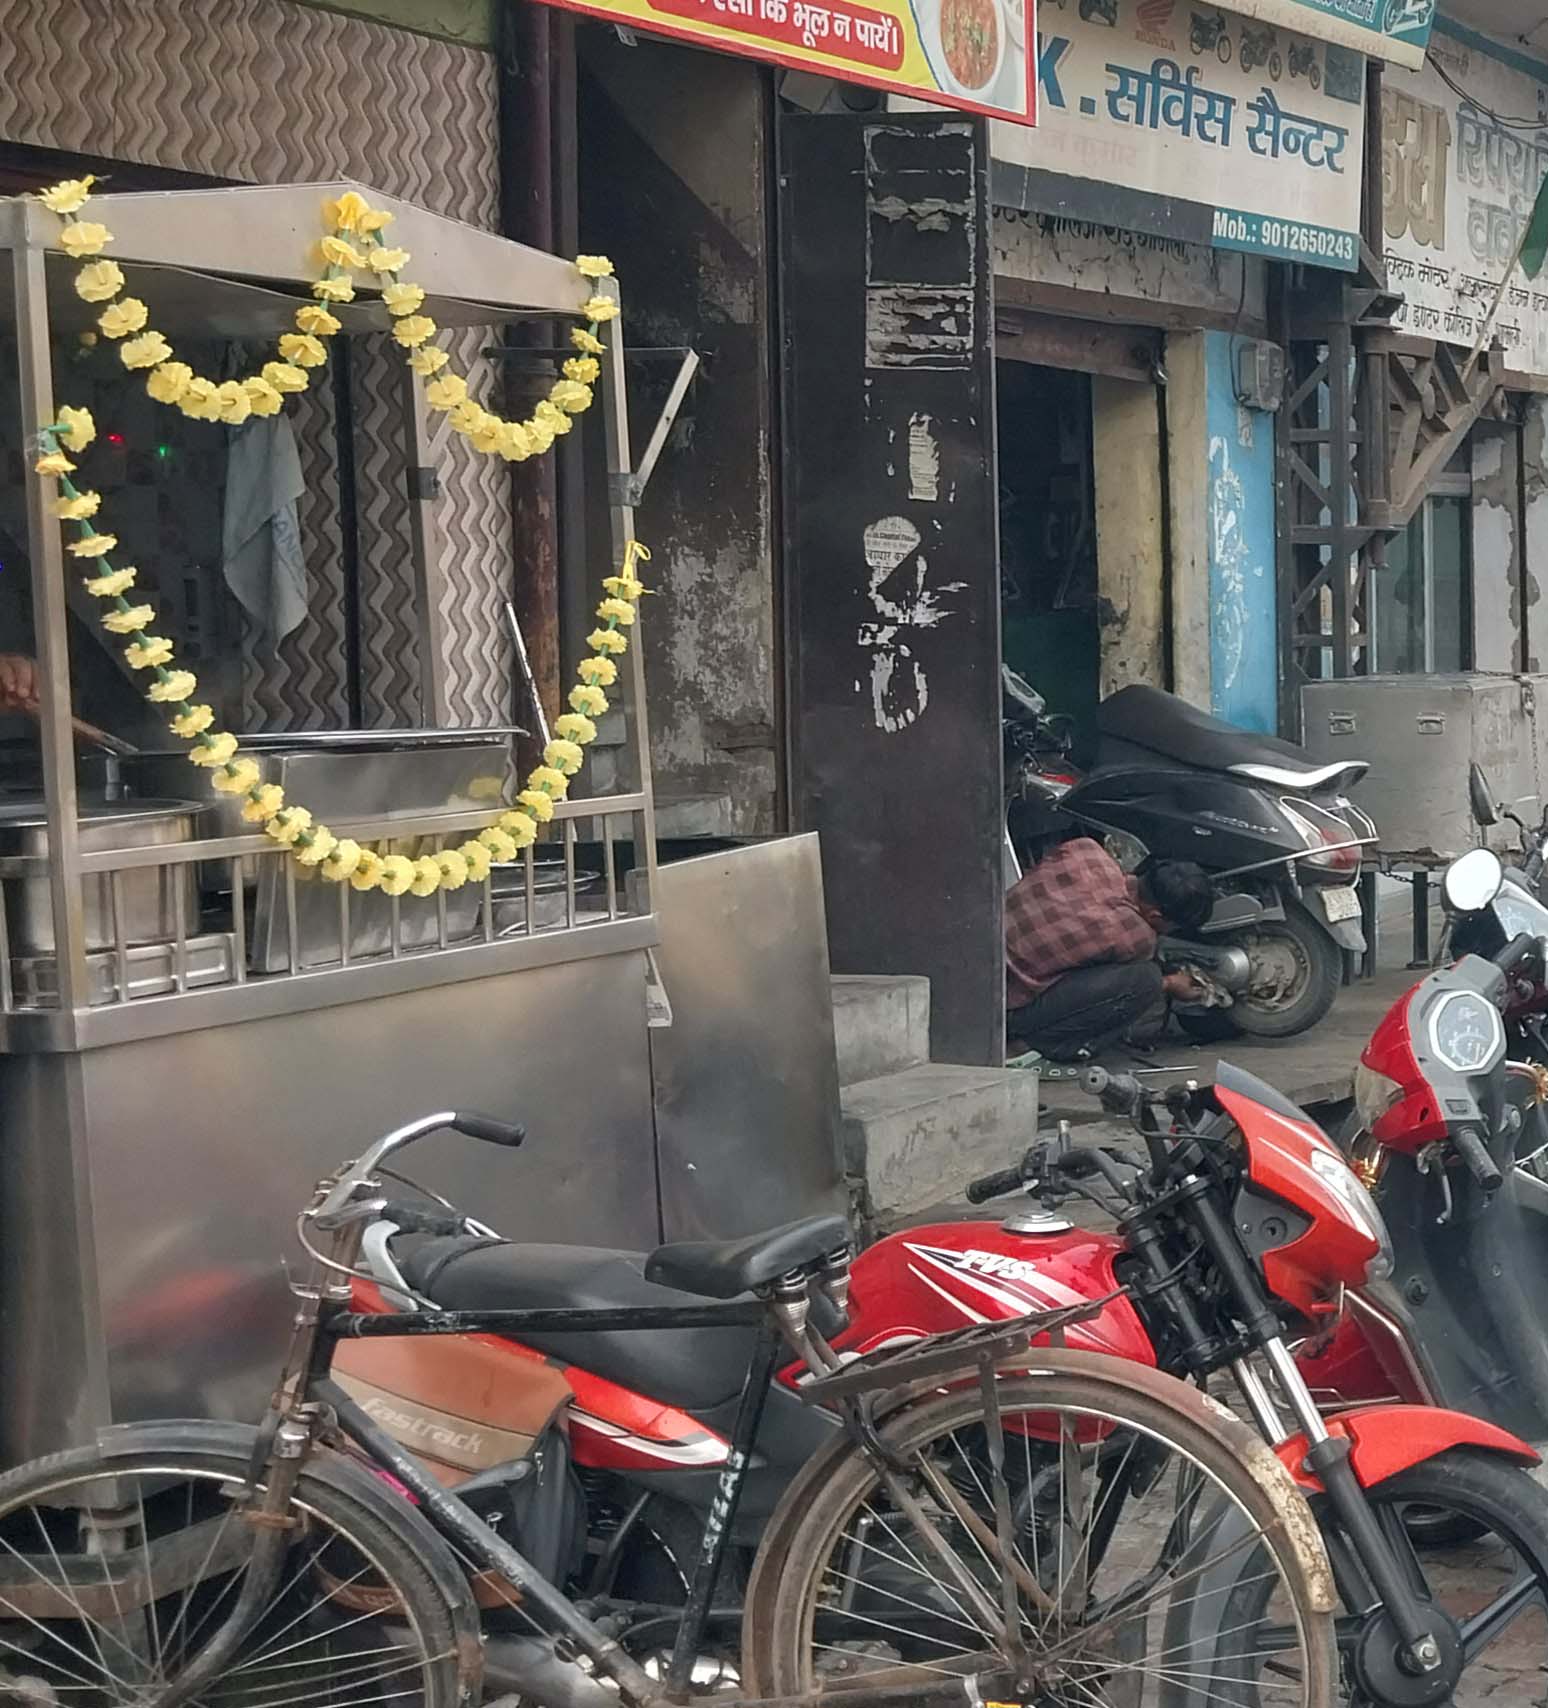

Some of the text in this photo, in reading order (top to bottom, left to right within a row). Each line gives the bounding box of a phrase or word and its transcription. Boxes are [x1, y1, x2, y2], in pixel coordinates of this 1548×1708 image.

[793, 3, 831, 48] भूल
[833, 12, 852, 43] न
[1104, 58, 1237, 148] सर्विस
[1212, 211, 1257, 244] Mob.:
[1261, 221, 1353, 261] 9012650243
[954, 1249, 1037, 1280] TVS
